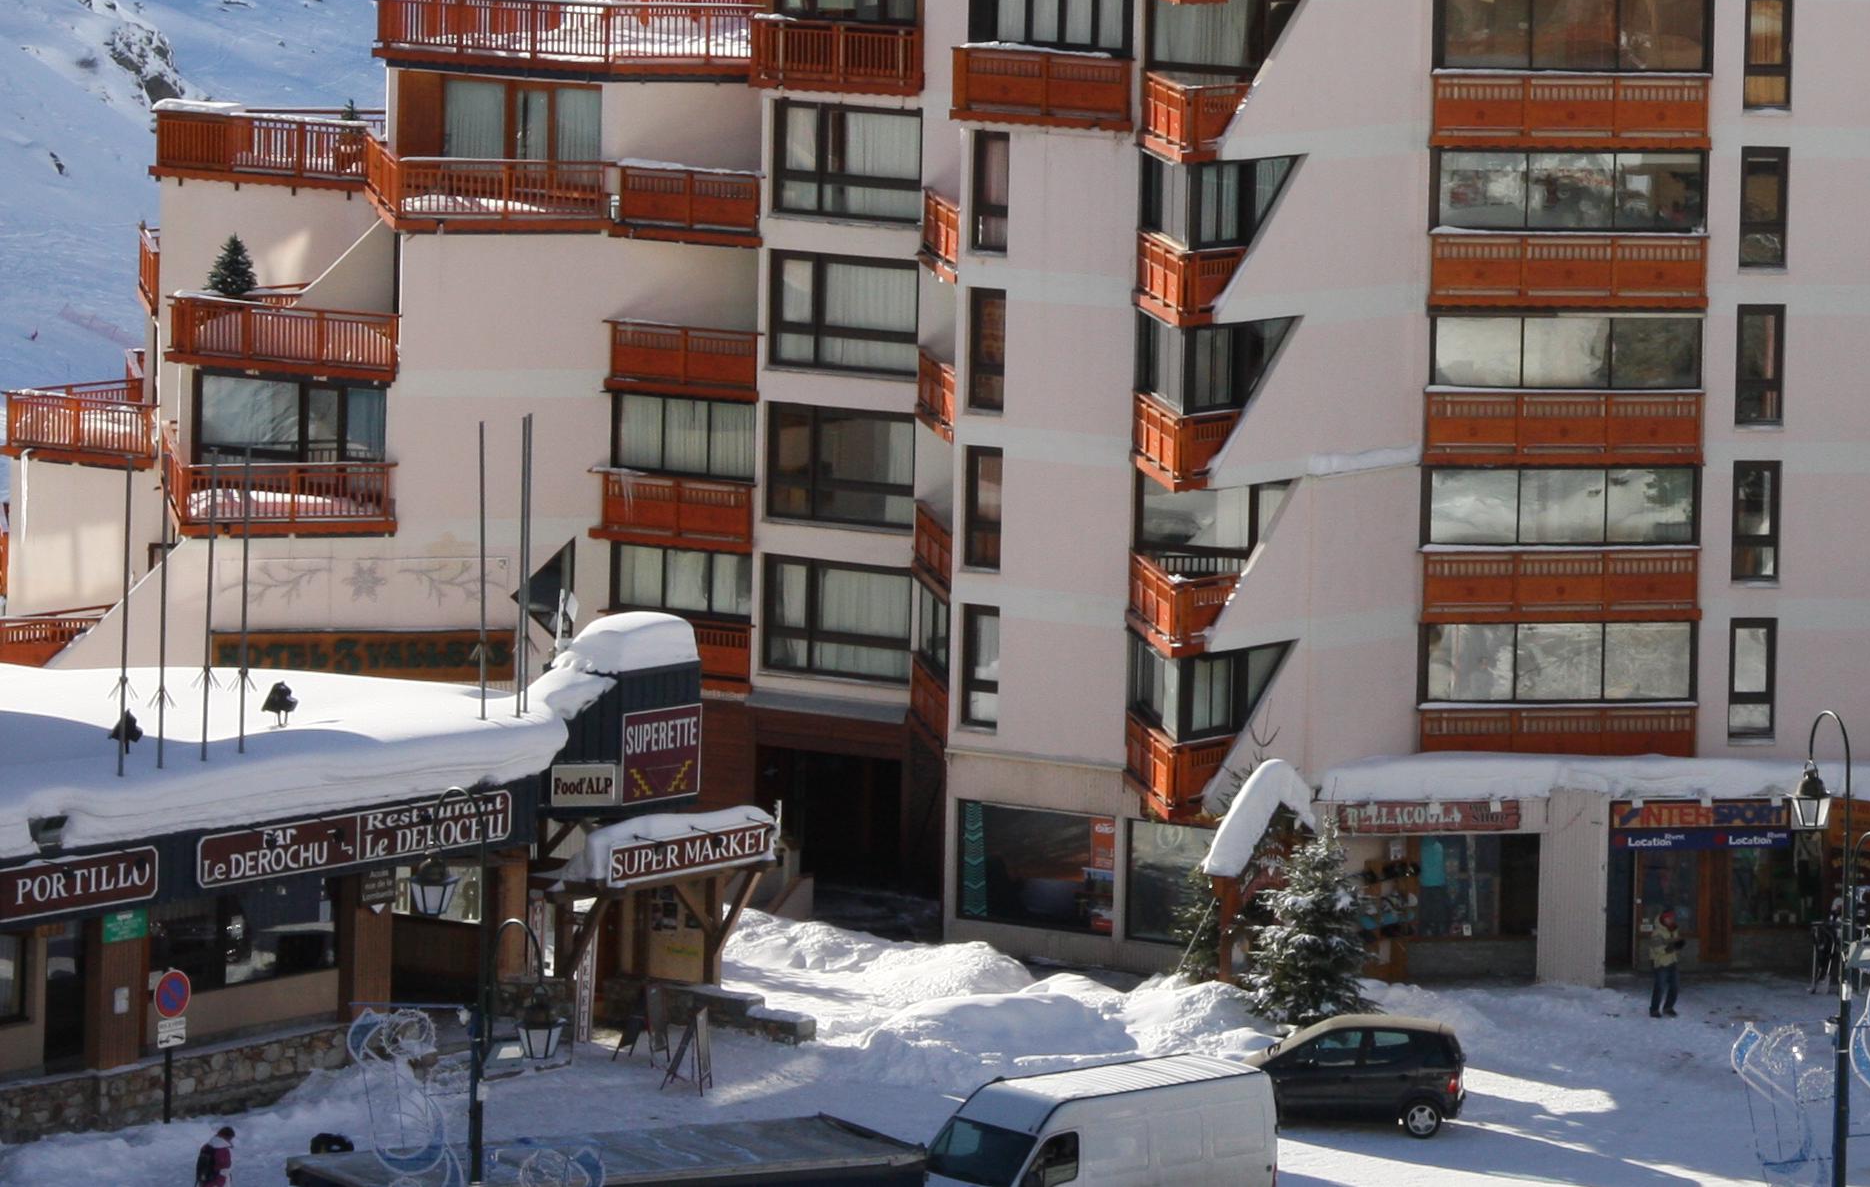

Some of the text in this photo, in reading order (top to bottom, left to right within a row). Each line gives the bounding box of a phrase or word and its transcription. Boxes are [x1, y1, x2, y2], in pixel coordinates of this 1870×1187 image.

[334, 639, 359, 674] 3
[626, 716, 697, 755] SUPERETTE
[365, 794, 505, 831] Resturant
[1640, 804, 1786, 825] INTERSPORT
[364, 834, 389, 859] Le
[613, 827, 767, 879] SUPER MARKET
[1628, 837, 1672, 846] Location
[1728, 835, 1772, 845] Location
[202, 841, 328, 883] Le DEROCHU
[15, 863, 150, 905] PORTILLO
